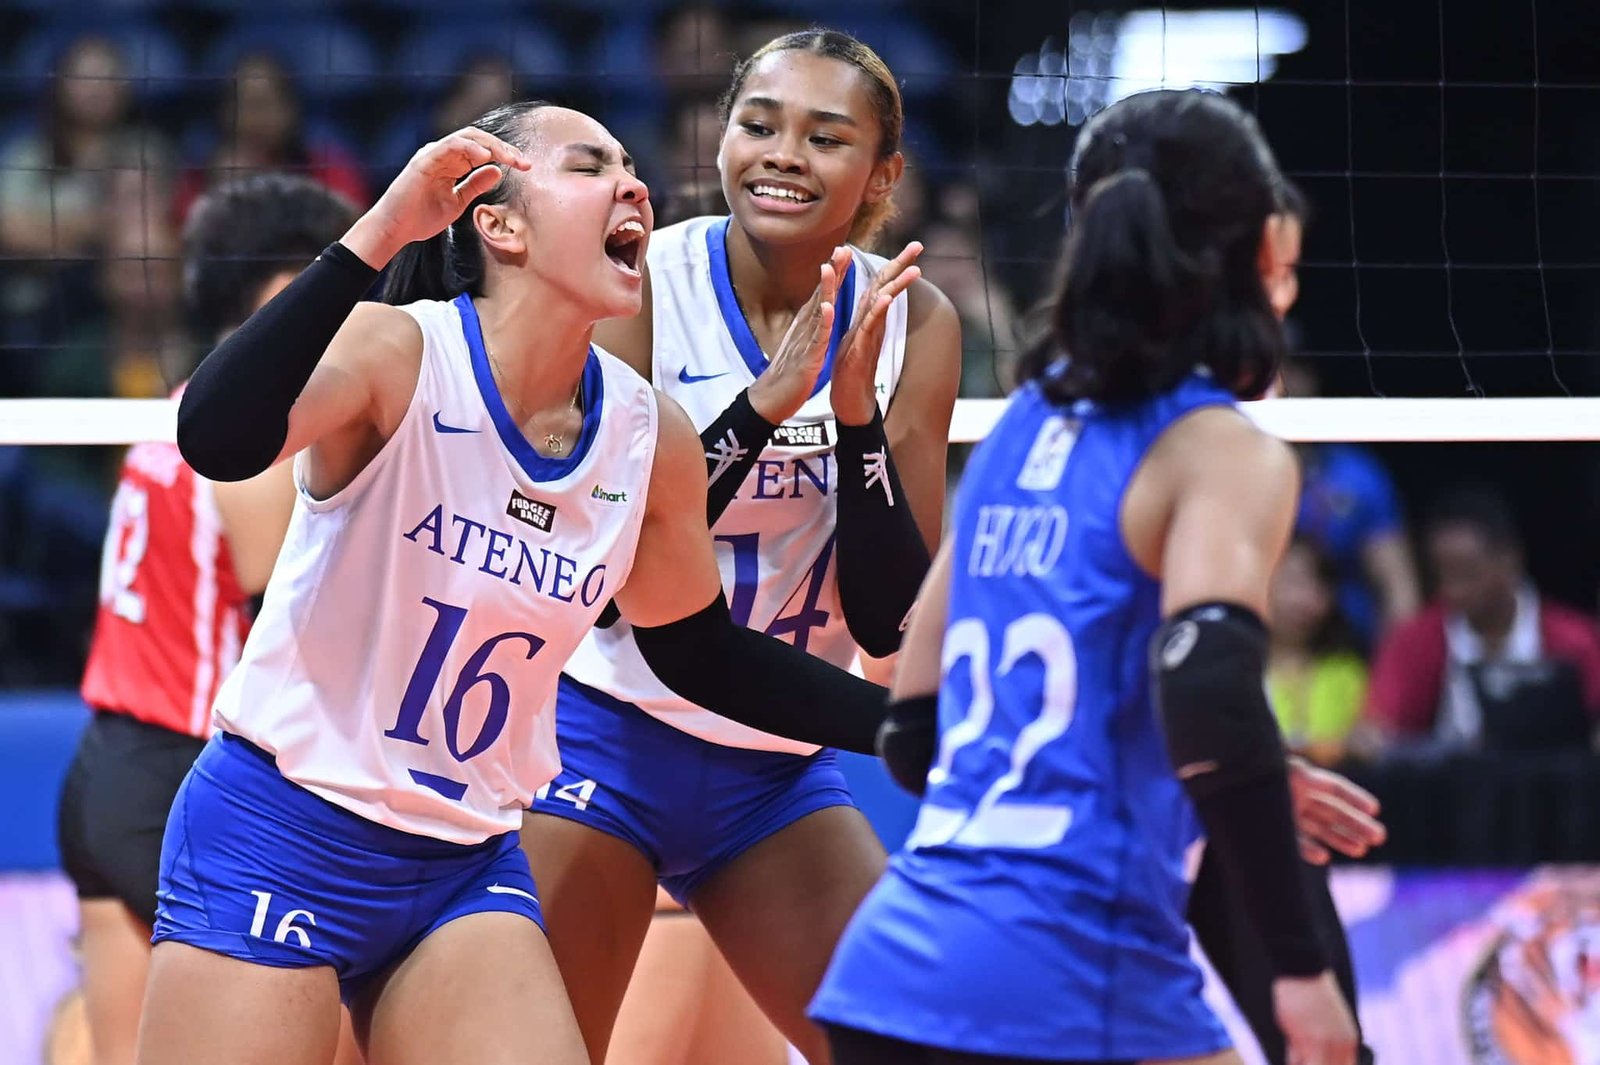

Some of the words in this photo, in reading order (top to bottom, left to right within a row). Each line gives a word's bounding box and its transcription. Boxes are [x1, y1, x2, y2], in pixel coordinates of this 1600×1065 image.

[402, 503, 607, 608] ATENEO
[511, 497, 551, 520] FUDGEE
[519, 509, 547, 529] BARR
[714, 532, 837, 652] 14
[384, 596, 547, 763] 16
[905, 612, 1078, 851] 22
[249, 890, 317, 949] 16
